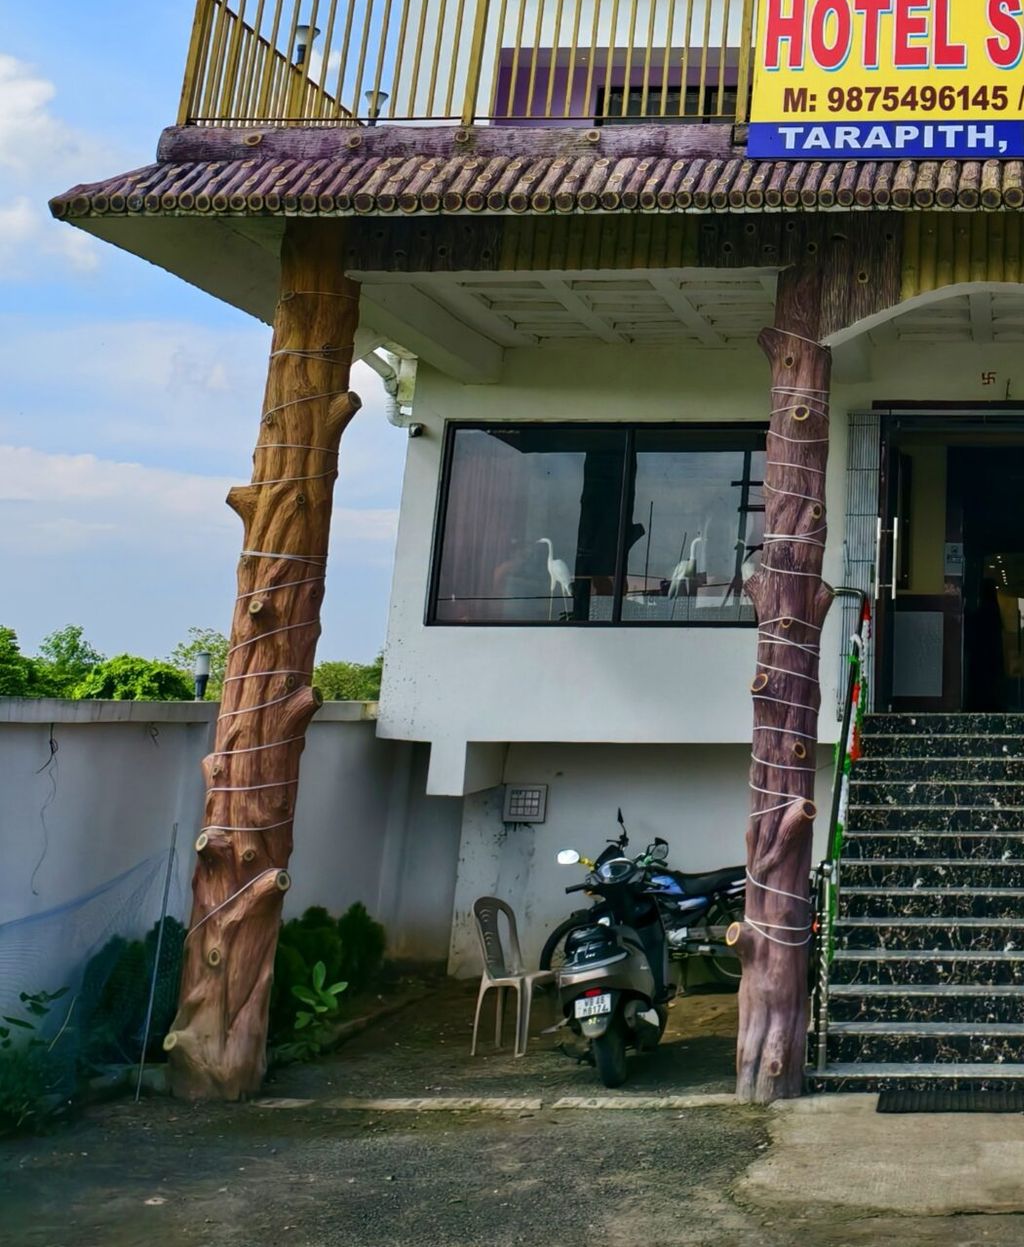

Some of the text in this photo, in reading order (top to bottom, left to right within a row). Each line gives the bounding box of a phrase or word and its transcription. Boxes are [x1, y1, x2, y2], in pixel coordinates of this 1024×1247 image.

[783, 87, 817, 113] M:
[827, 85, 1008, 112] 9875496145
[778, 125, 1008, 153] TARAPITH,
